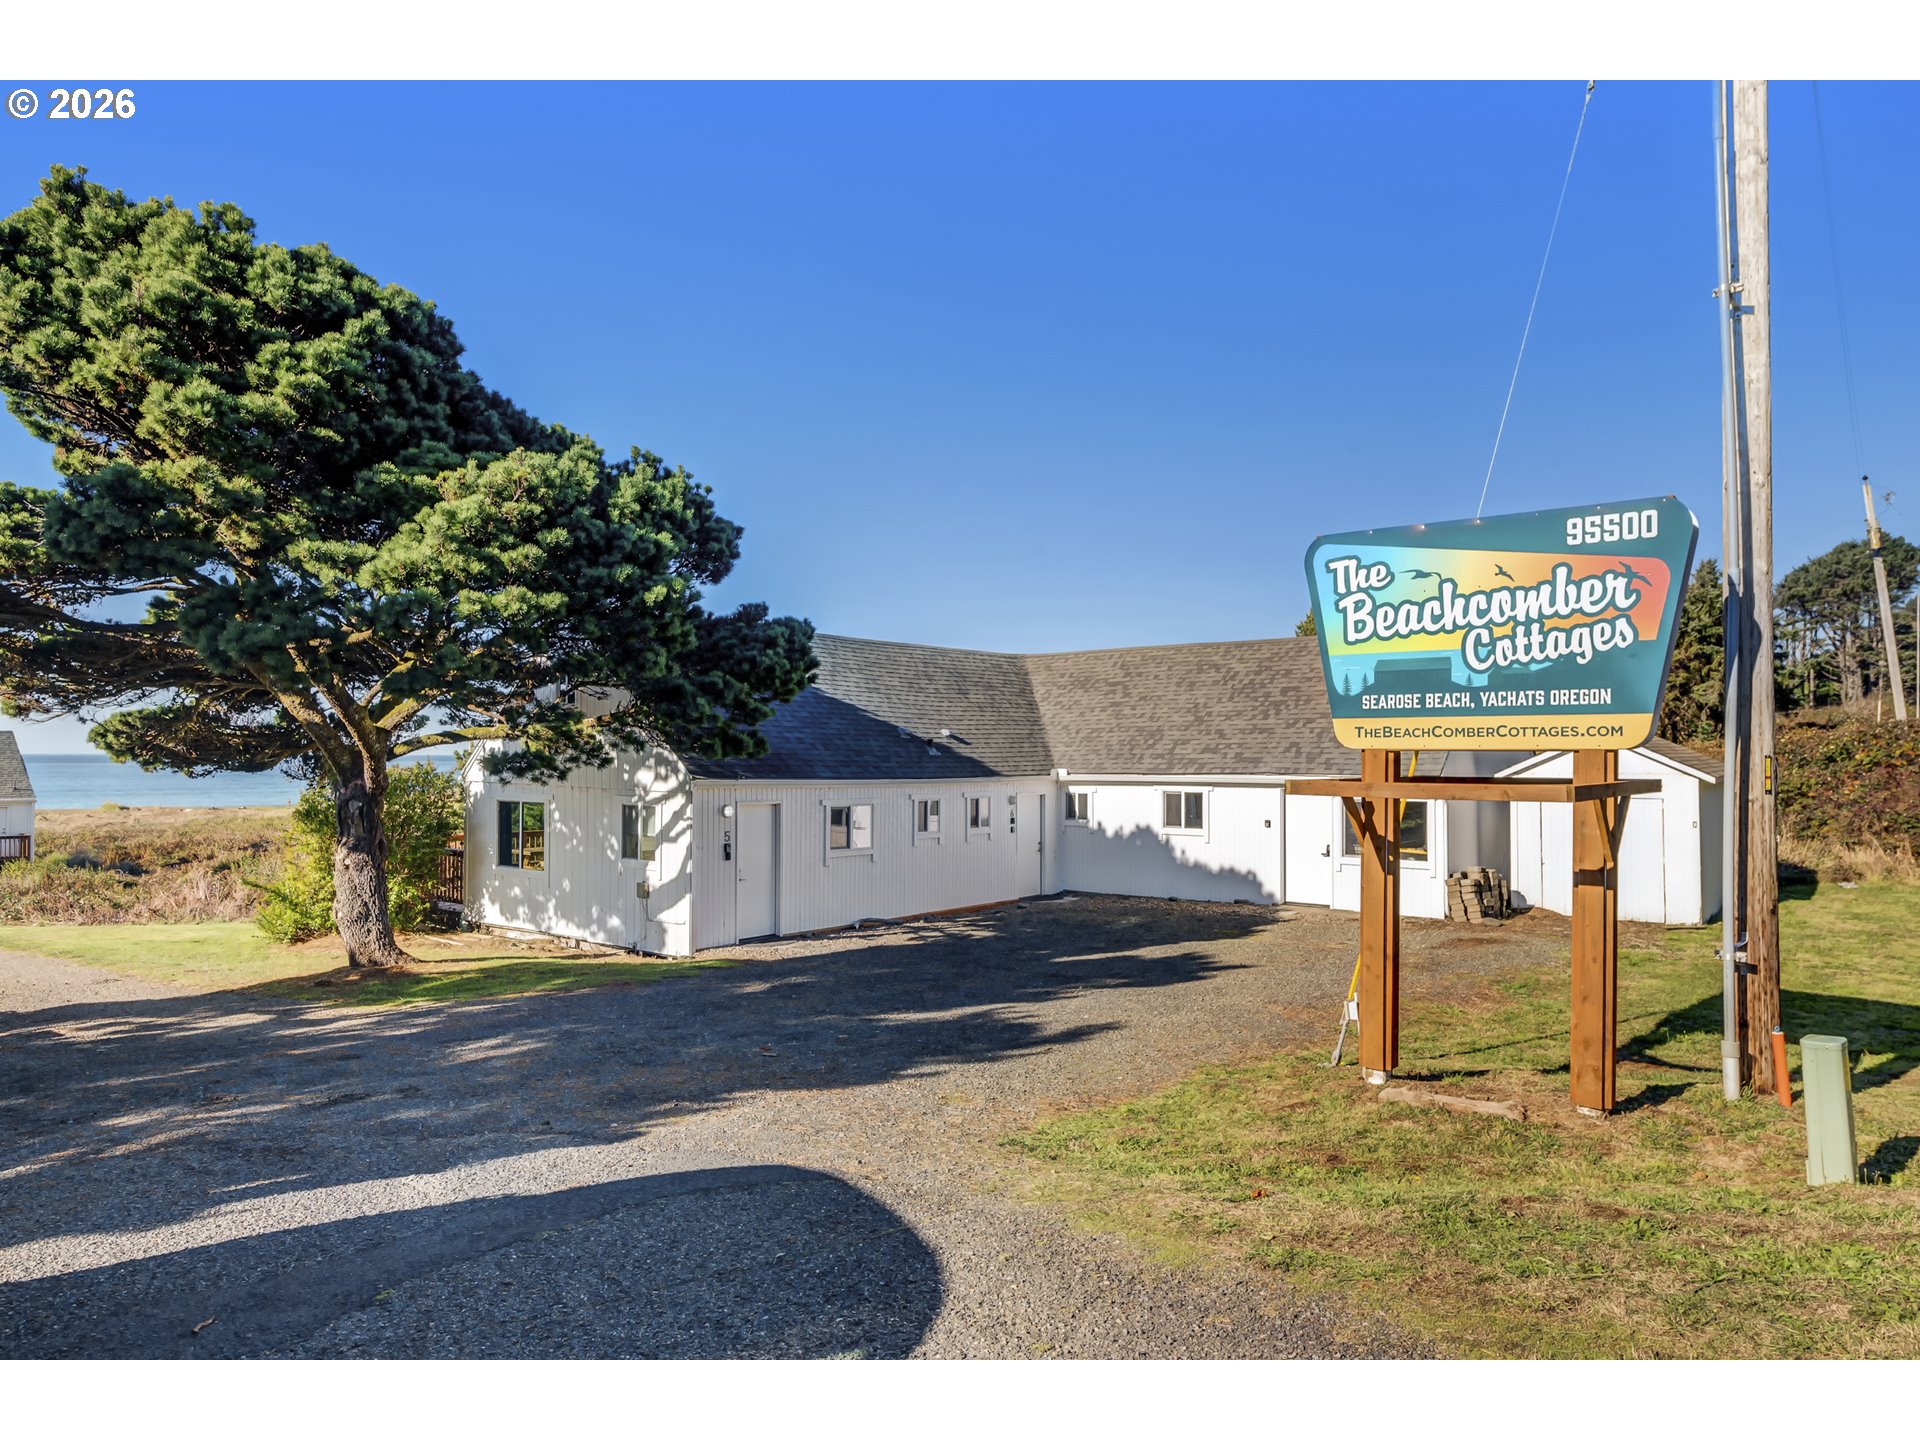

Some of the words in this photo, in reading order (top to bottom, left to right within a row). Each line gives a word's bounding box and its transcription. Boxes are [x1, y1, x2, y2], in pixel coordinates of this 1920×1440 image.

[1566, 509, 1658, 546] 95500
[1328, 558, 1391, 594] The
[1338, 566, 1637, 642] Beachcomber
[1465, 617, 1634, 671] Cottages
[1362, 693, 1422, 710] SEAROSE
[1425, 692, 1475, 709] BEACH,
[1479, 690, 1545, 707] YACHATS
[1550, 688, 1612, 706] OREGON
[724, 831, 731, 843] 5
